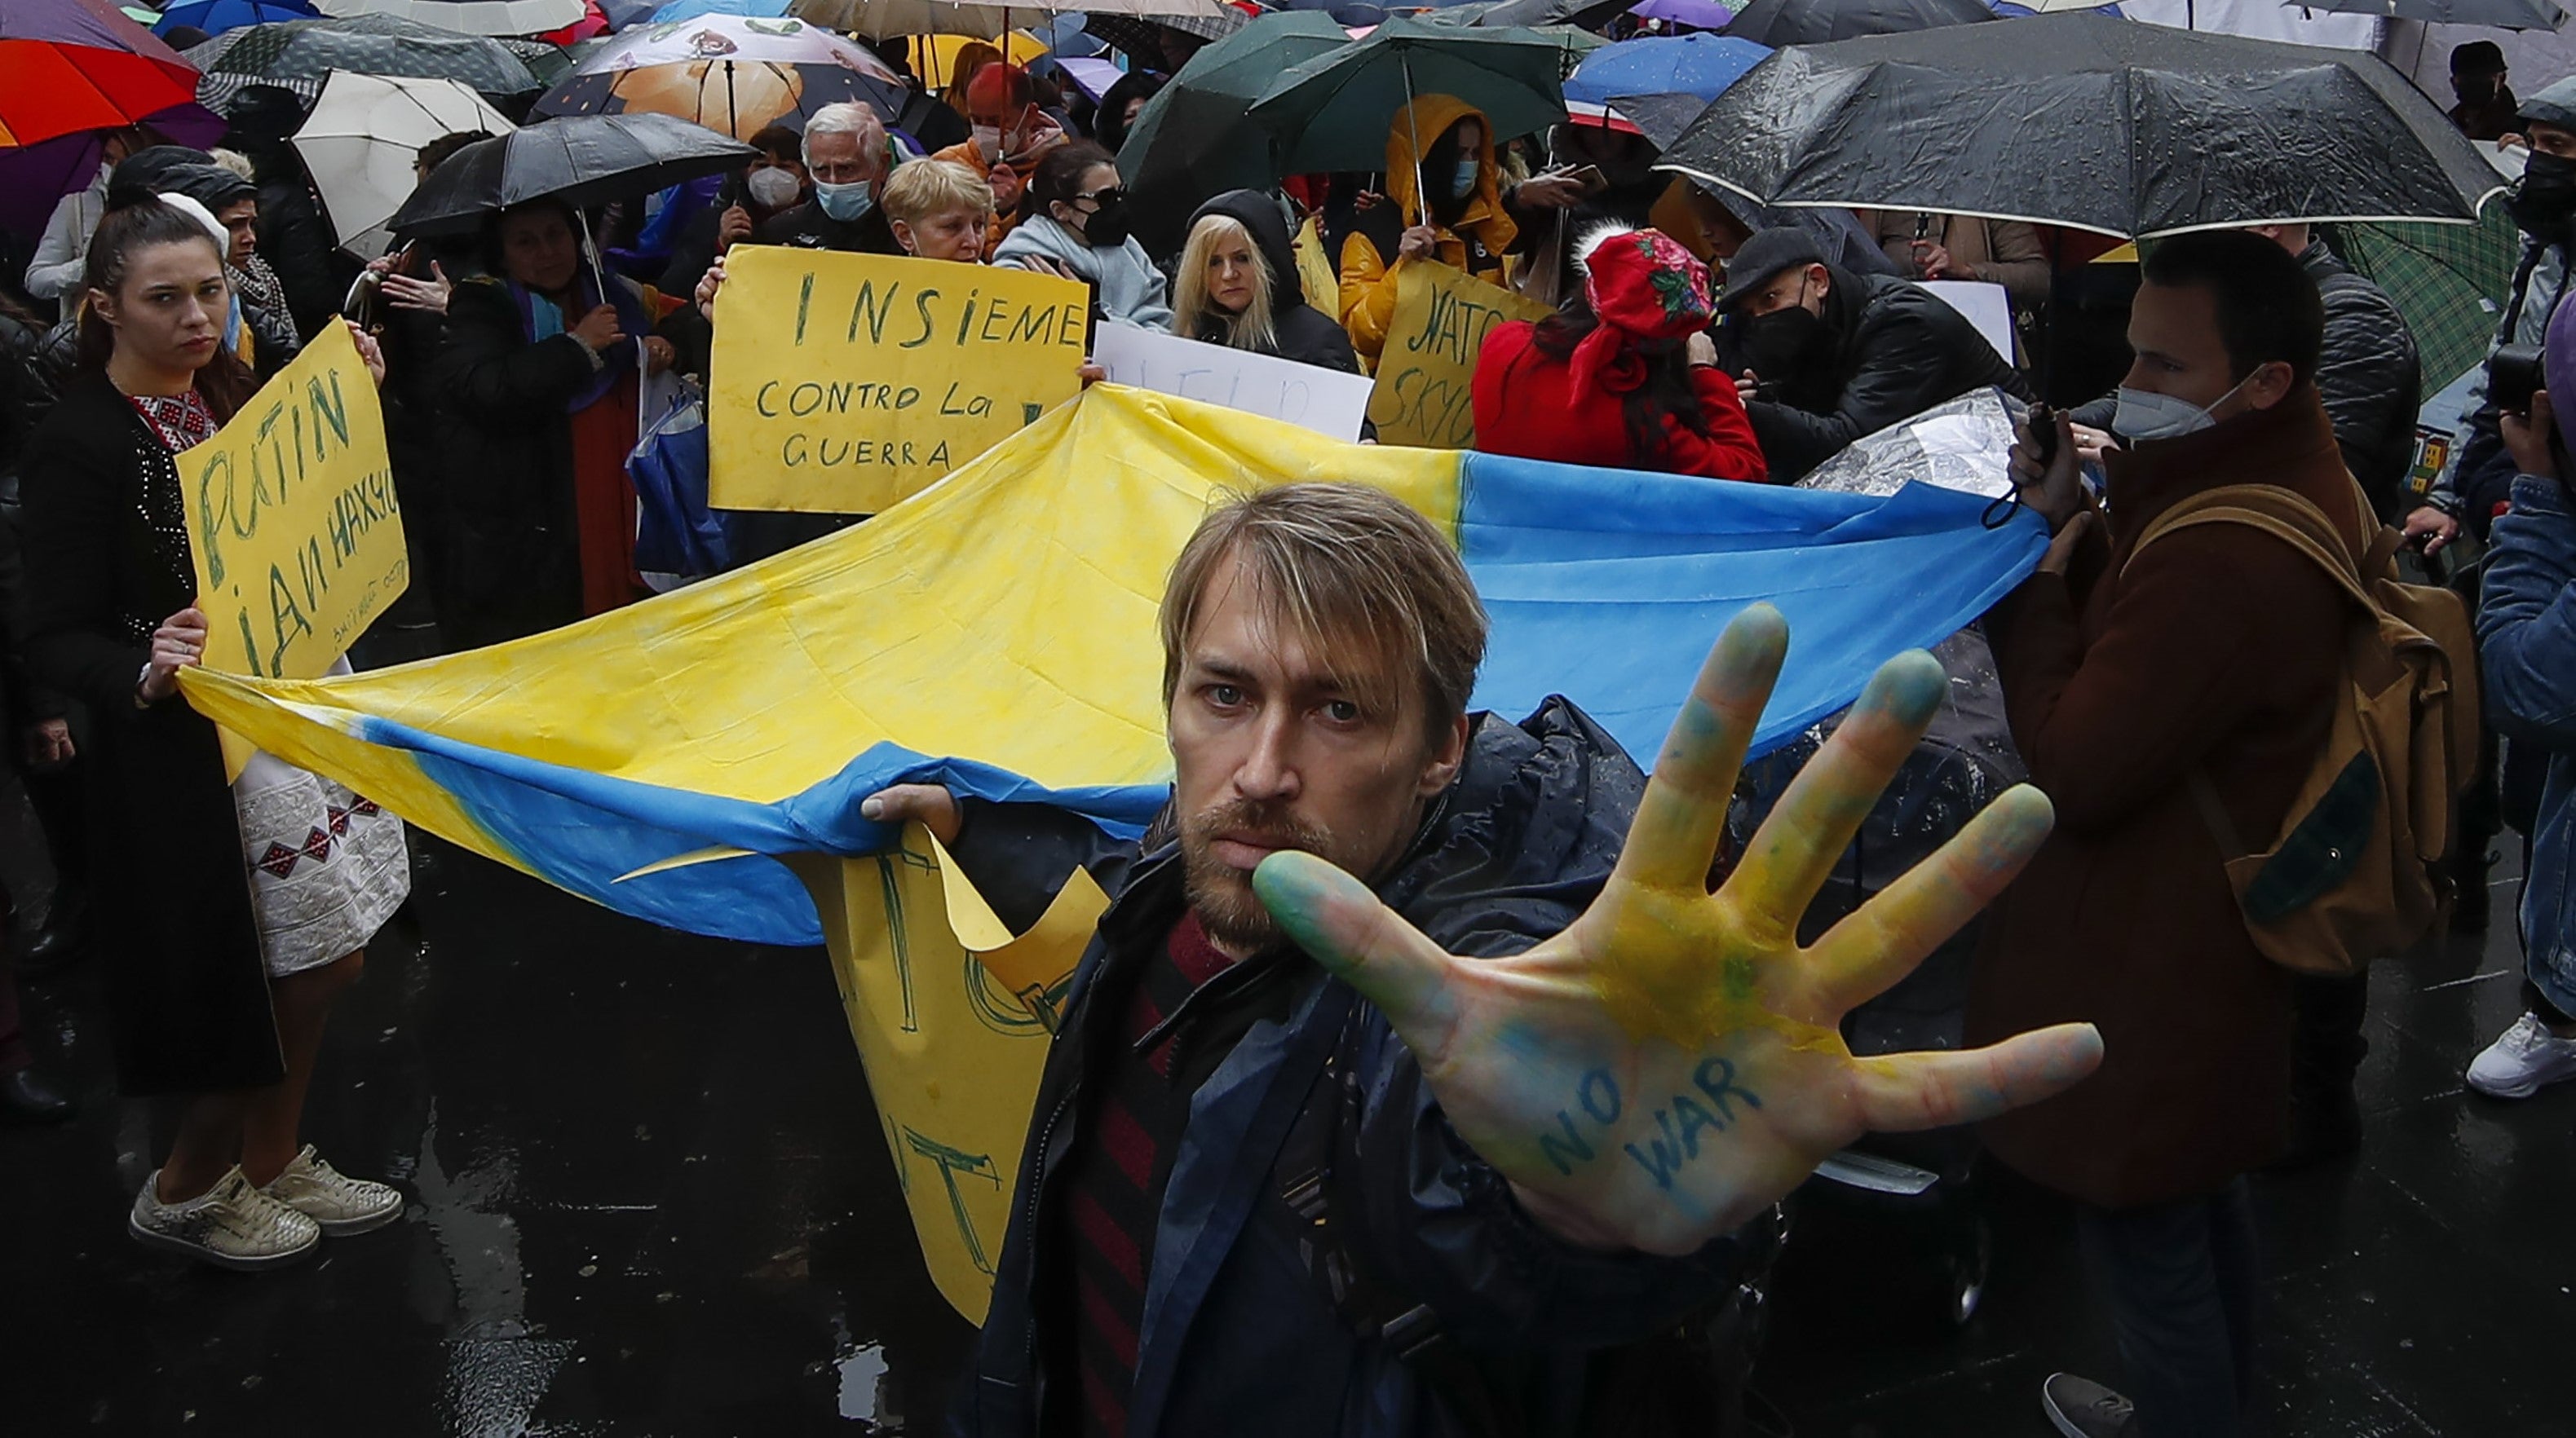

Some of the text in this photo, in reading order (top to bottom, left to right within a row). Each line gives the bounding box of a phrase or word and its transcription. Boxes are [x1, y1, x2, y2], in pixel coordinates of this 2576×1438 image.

[757, 380, 921, 417] CONTRO
[783, 433, 952, 471] GUERRA
[1540, 1065, 1622, 1176] NO
[1624, 1057, 1763, 1191] WAR
